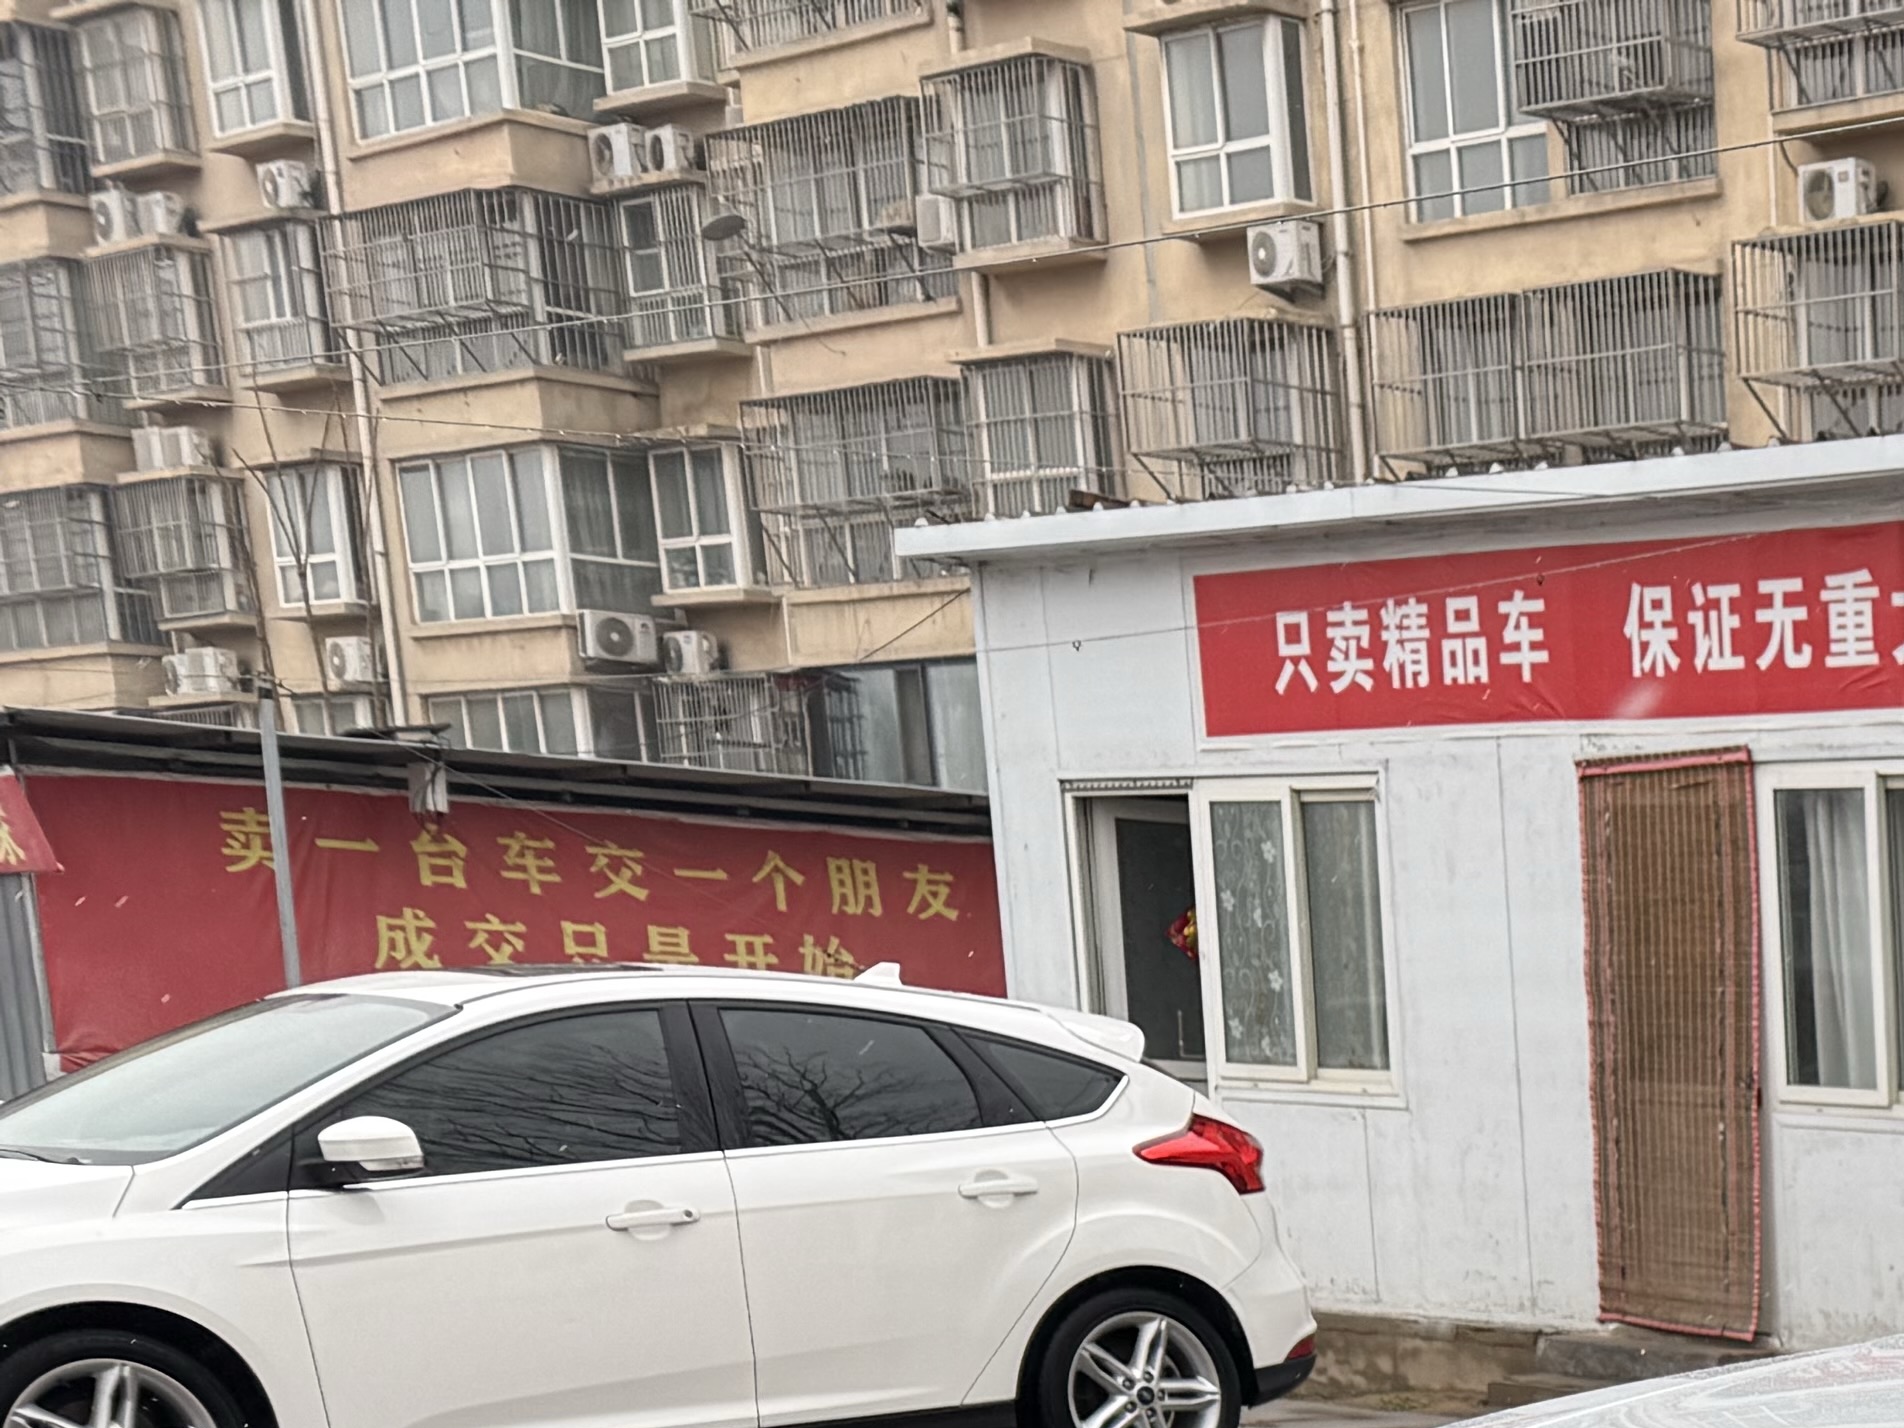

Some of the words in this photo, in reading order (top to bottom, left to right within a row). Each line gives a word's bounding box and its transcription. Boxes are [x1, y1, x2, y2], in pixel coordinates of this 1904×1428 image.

[1274, 588, 1551, 696] 只卖精品车
[219, 806, 961, 922] 卖一台车交一个朋友
